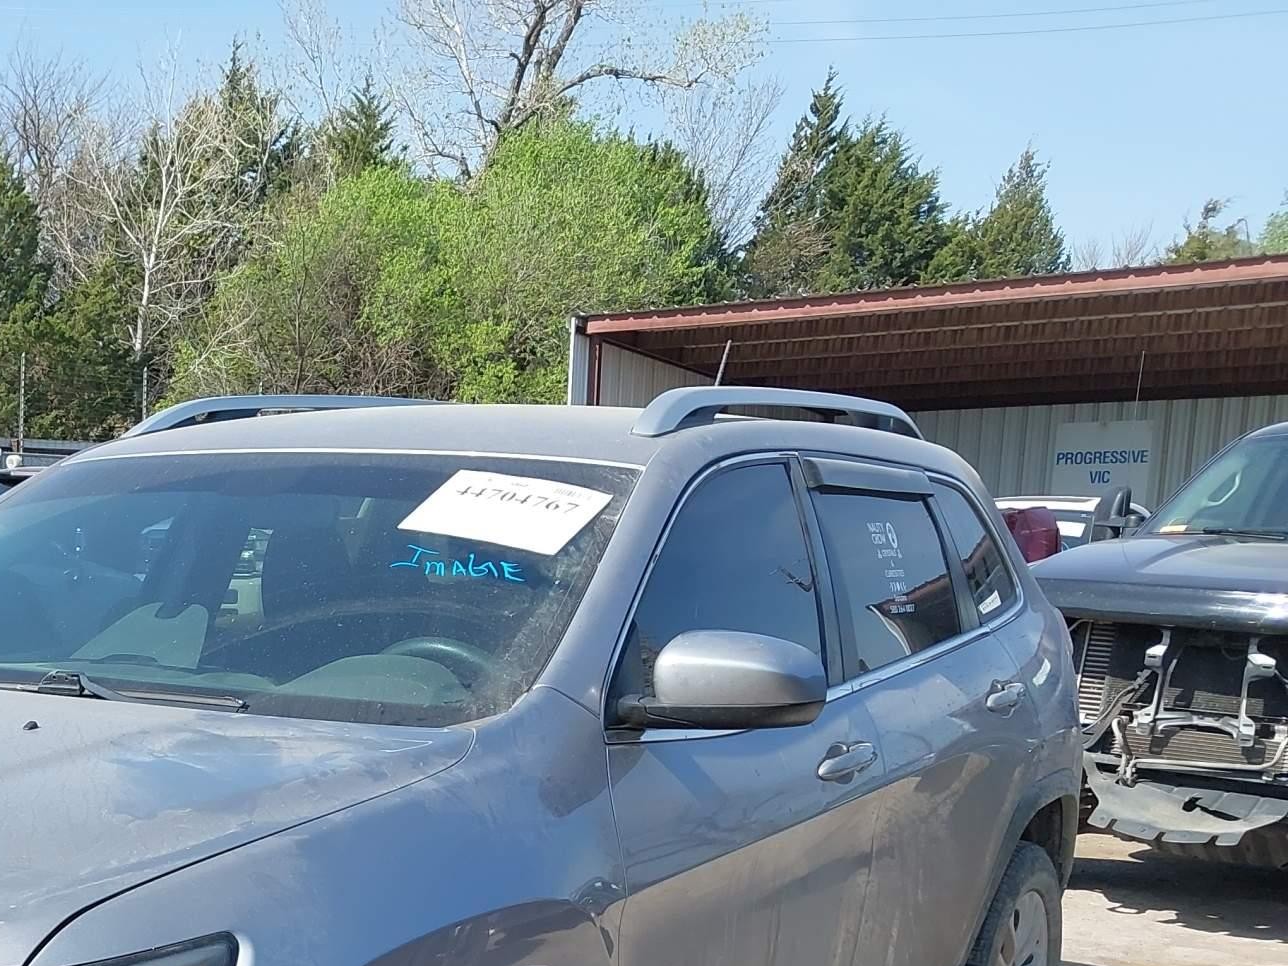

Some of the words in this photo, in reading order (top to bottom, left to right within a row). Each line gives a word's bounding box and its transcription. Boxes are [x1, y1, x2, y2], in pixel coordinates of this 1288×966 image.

[1055, 449, 1149, 466] PROGRESSIVE
[1089, 470, 1110, 484] VIC
[456, 486, 580, 513] 44704767
